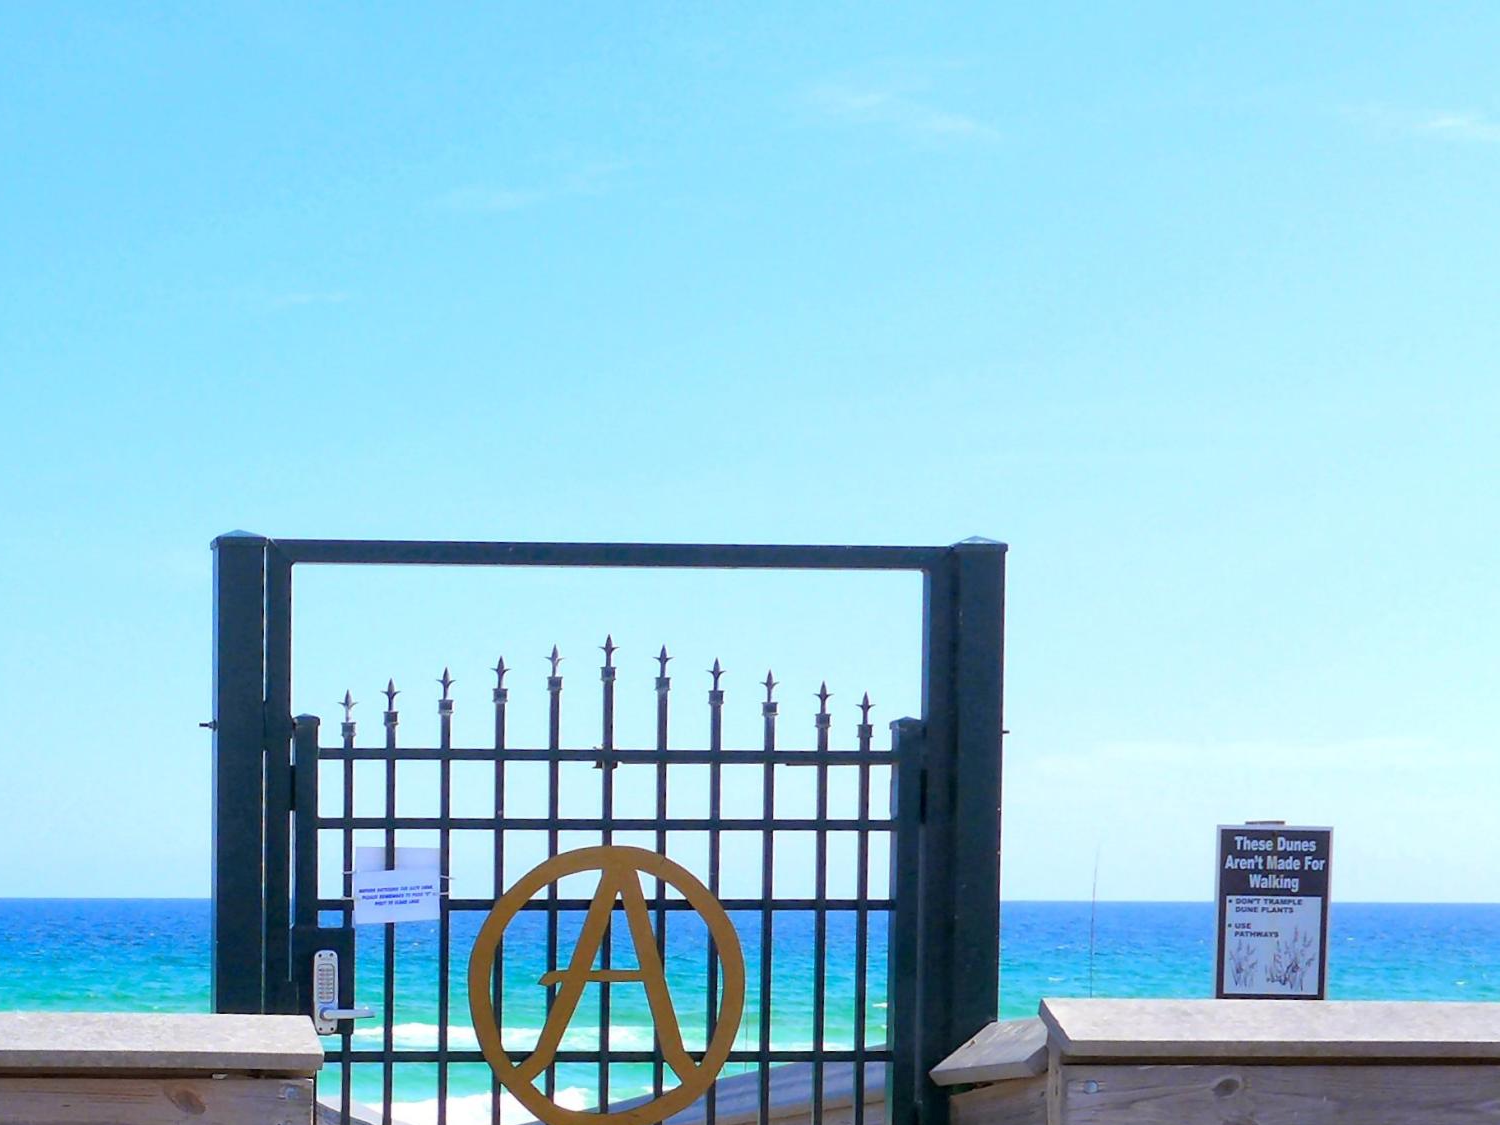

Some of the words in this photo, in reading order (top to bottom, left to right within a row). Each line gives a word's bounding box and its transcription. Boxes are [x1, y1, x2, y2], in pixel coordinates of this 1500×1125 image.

[1234, 836, 1273, 850] These
[1277, 837, 1316, 852] Dunes
[1225, 855, 1263, 870] Aren't
[1266, 856, 1300, 870] Made
[1304, 857, 1326, 871] For
[1249, 874, 1300, 892] Walking
